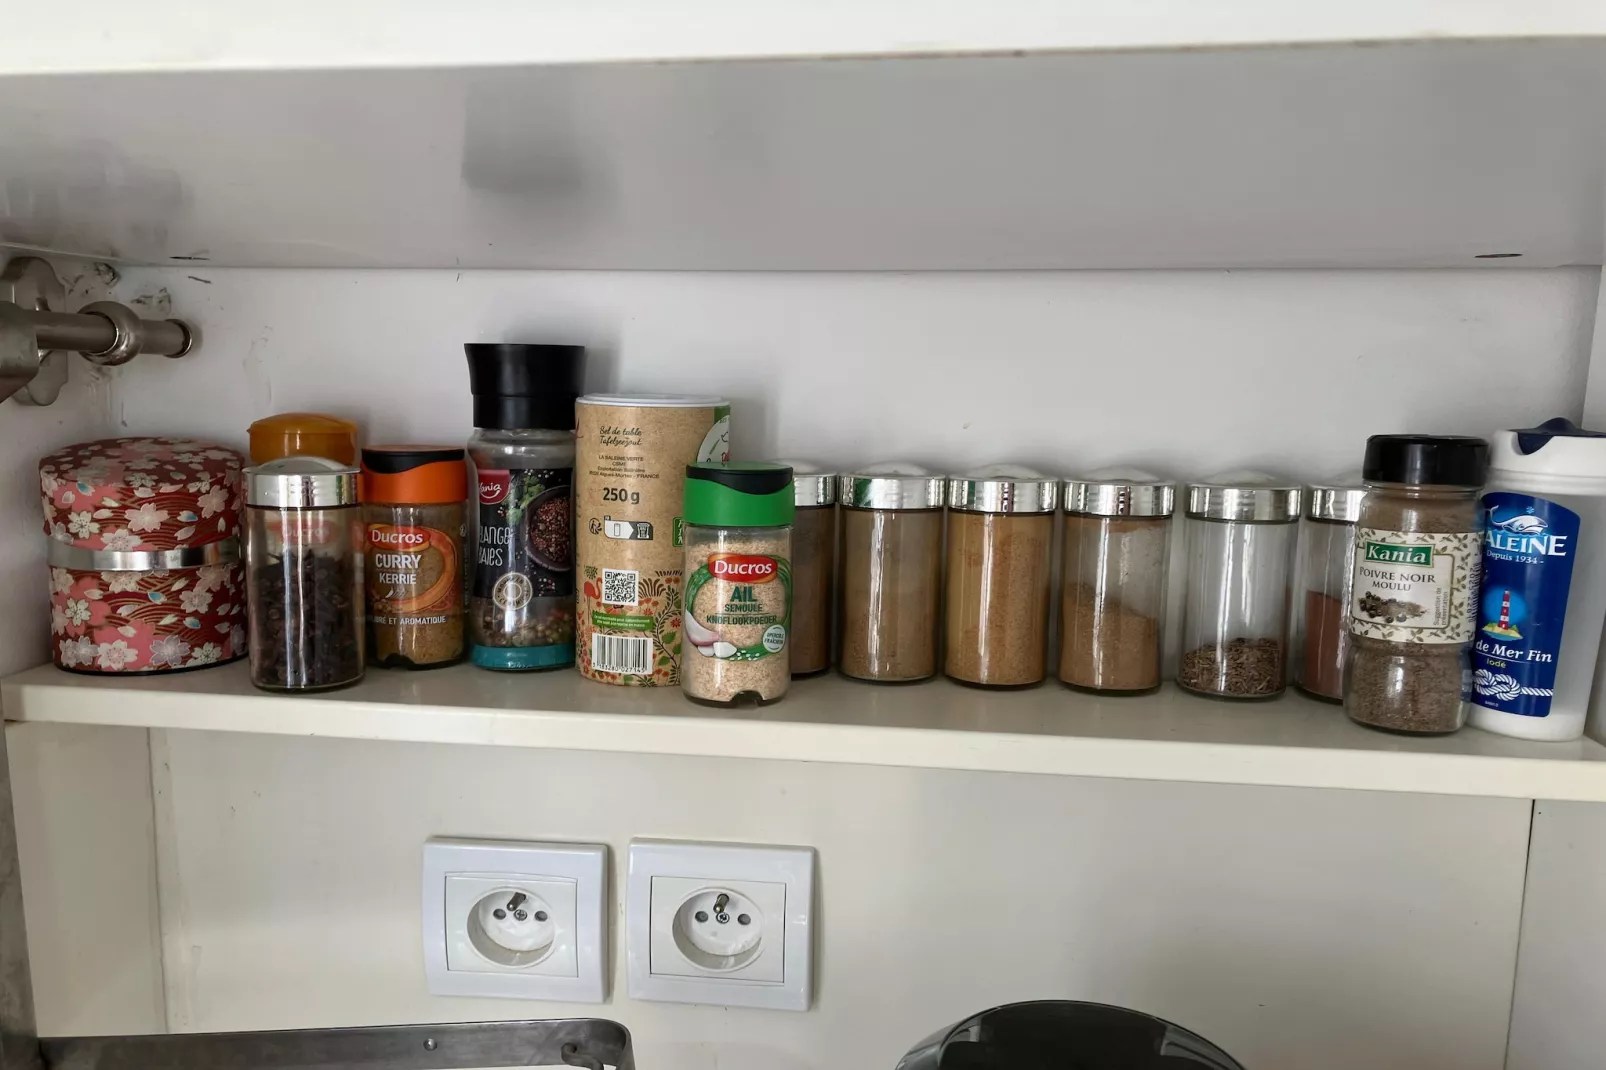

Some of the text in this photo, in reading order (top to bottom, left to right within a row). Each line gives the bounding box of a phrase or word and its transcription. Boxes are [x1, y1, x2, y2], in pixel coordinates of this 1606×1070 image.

[612, 427, 620, 435] de
[622, 428, 642, 436] table
[603, 487, 640, 504] 250 g
[371, 529, 424, 544] Ducros
[1485, 530, 1568, 556] ALEINE
[375, 553, 422, 569] CURRY
[1367, 545, 1428, 563] Kania
[1487, 549, 1513, 561] Depuis
[1515, 555, 1537, 565] 1934
[714, 560, 772, 575] Ducros
[1359, 566, 1436, 583] POIVRE NOIR
[379, 572, 417, 585] KERRIE
[1372, 581, 1412, 591] MOULU
[729, 586, 758, 603] AIL
[724, 603, 763, 613] SEMOULE
[388, 617, 398, 625] ET
[400, 615, 446, 625] AROMATIQUE
[706, 615, 777, 625] KNOFLOOKPOEDER
[1476, 640, 1552, 662] de Mer Fin
